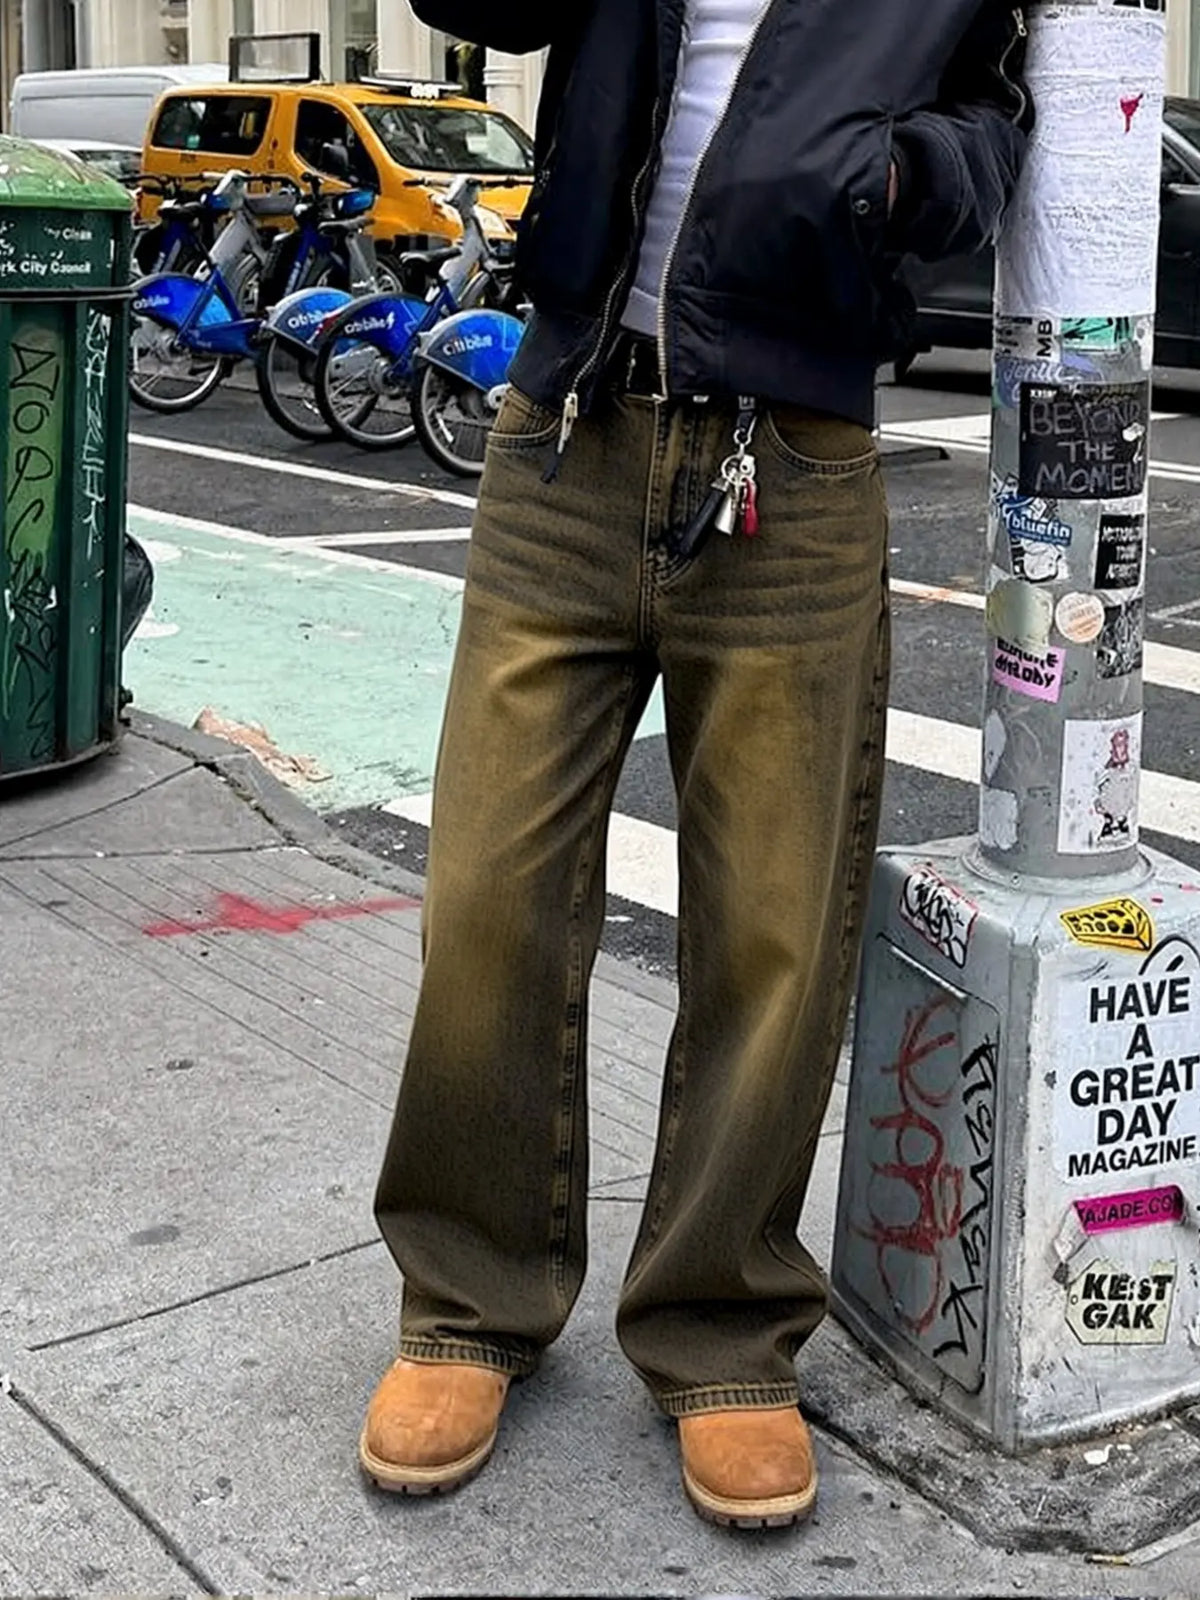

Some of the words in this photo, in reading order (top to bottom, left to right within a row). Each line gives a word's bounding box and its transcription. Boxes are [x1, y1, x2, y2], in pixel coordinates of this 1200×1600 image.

[1030, 400, 1141, 438] BEYOND
[1057, 440, 1115, 463] THE
[1012, 513, 1070, 538] bluefin
[1089, 976, 1191, 1023] HAVE
[1126, 1023, 1153, 1060] A
[1070, 1055, 1200, 1107] GREAT
[1097, 1099, 1177, 1146] DAY
[1068, 1136, 1196, 1177] MAGAZINE
[1082, 1302, 1157, 1330] GAK
